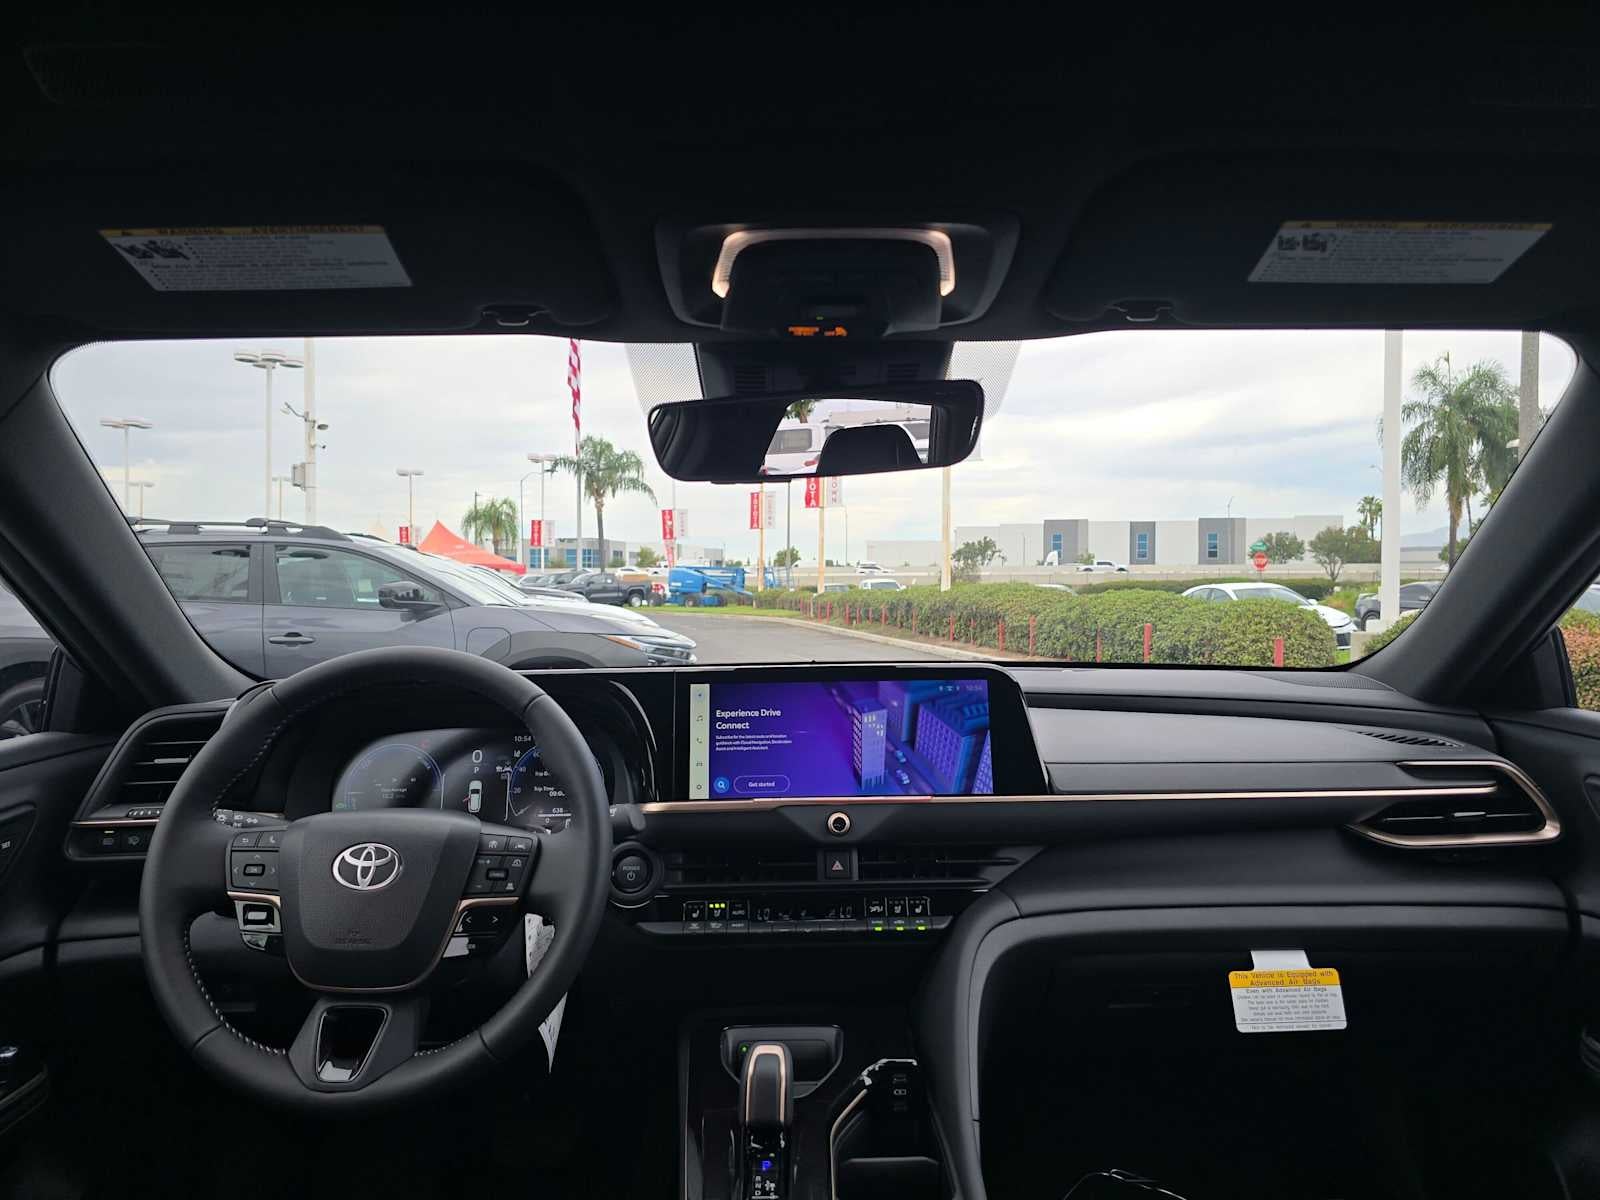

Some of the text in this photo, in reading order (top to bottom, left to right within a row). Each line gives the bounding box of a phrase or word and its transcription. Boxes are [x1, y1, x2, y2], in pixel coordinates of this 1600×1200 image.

[716, 709, 759, 718] Experience
[716, 721, 750, 730] Connect
[1250, 978, 1284, 986] Advanced
[762, 1160, 772, 1171] P
